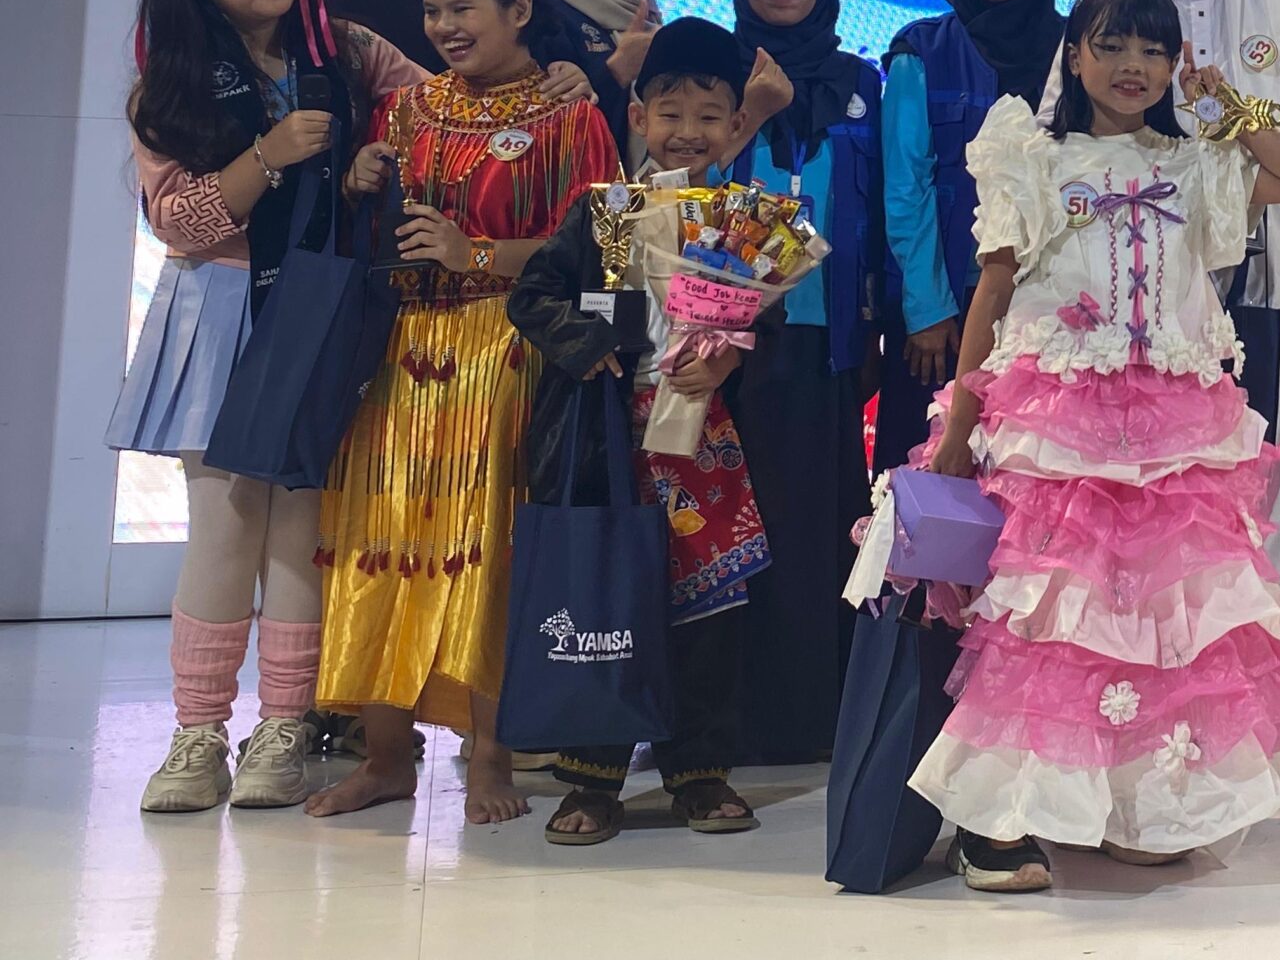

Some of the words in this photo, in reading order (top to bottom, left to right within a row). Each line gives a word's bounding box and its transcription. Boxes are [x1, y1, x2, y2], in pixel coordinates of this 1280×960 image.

[1249, 40, 1271, 64] 53
[498, 136, 527, 153] 49
[1067, 196, 1089, 215] 51
[576, 629, 634, 652] YAMSA
